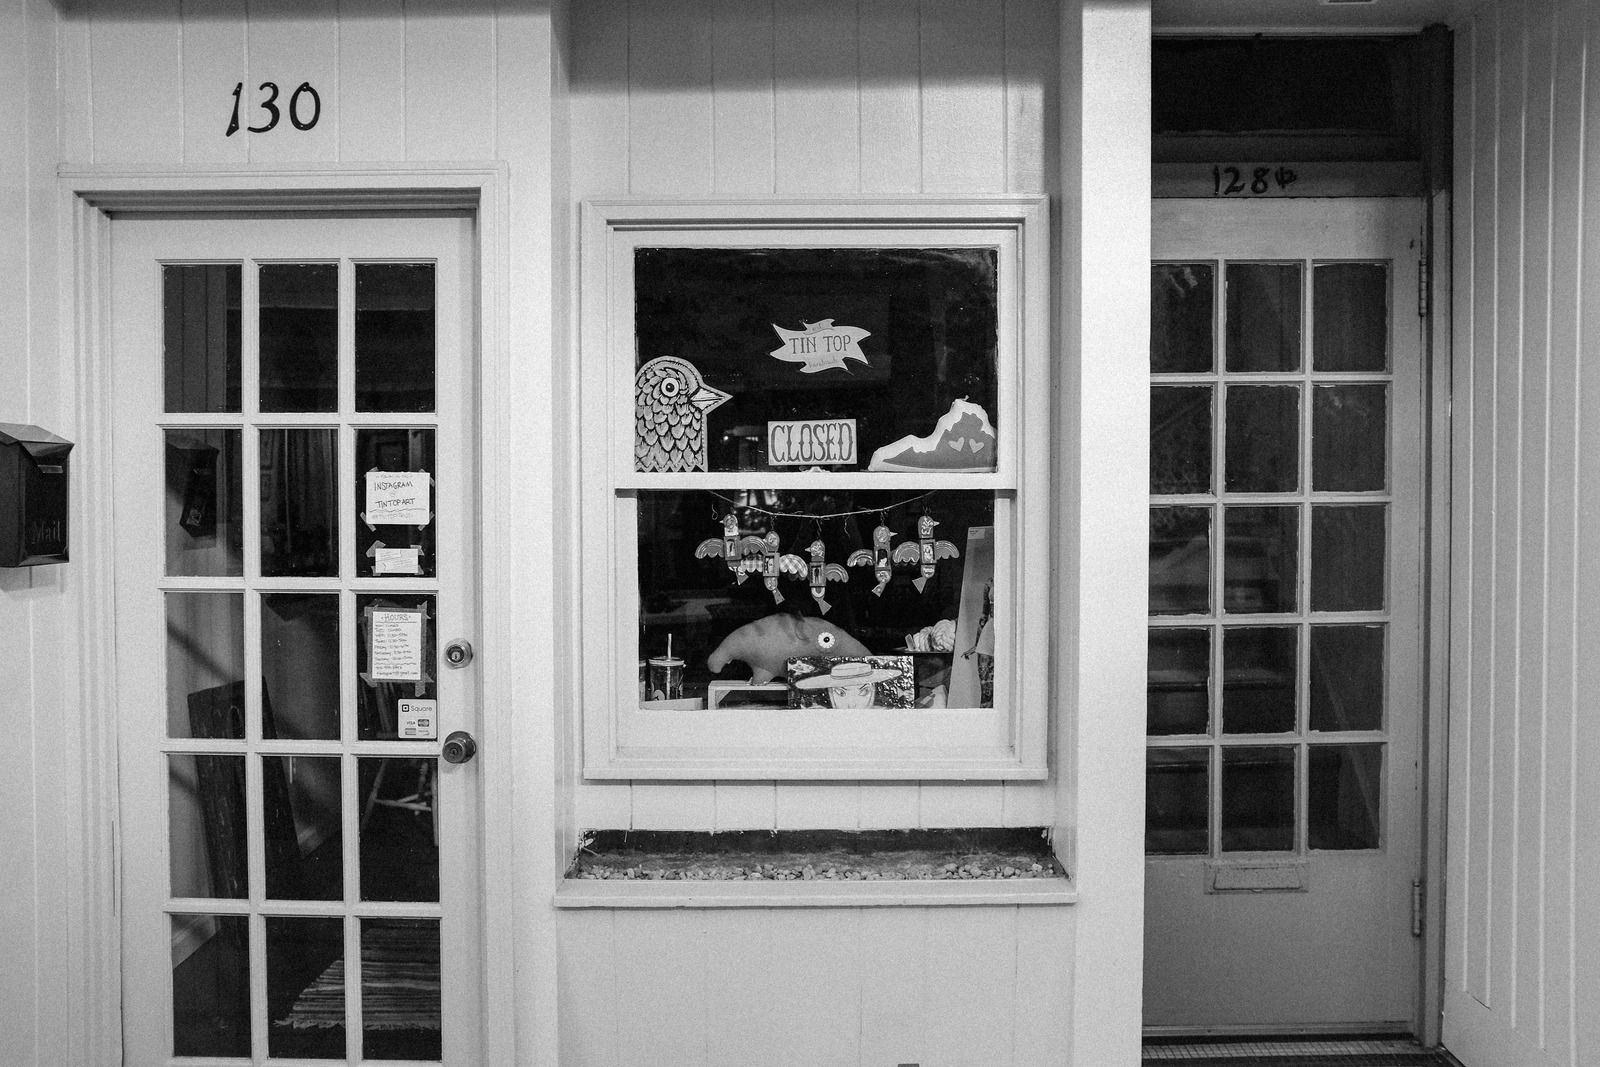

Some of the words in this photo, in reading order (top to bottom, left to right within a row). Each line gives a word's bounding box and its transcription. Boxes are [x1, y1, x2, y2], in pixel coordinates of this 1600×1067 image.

[226, 82, 321, 137] 130
[789, 336, 817, 354] TIN
[823, 335, 851, 353] TOP
[770, 422, 854, 463] CLOSED
[374, 481, 413, 492] INSTAGRAM
[31, 520, 61, 545] Mail
[384, 613, 409, 621] HOURS
